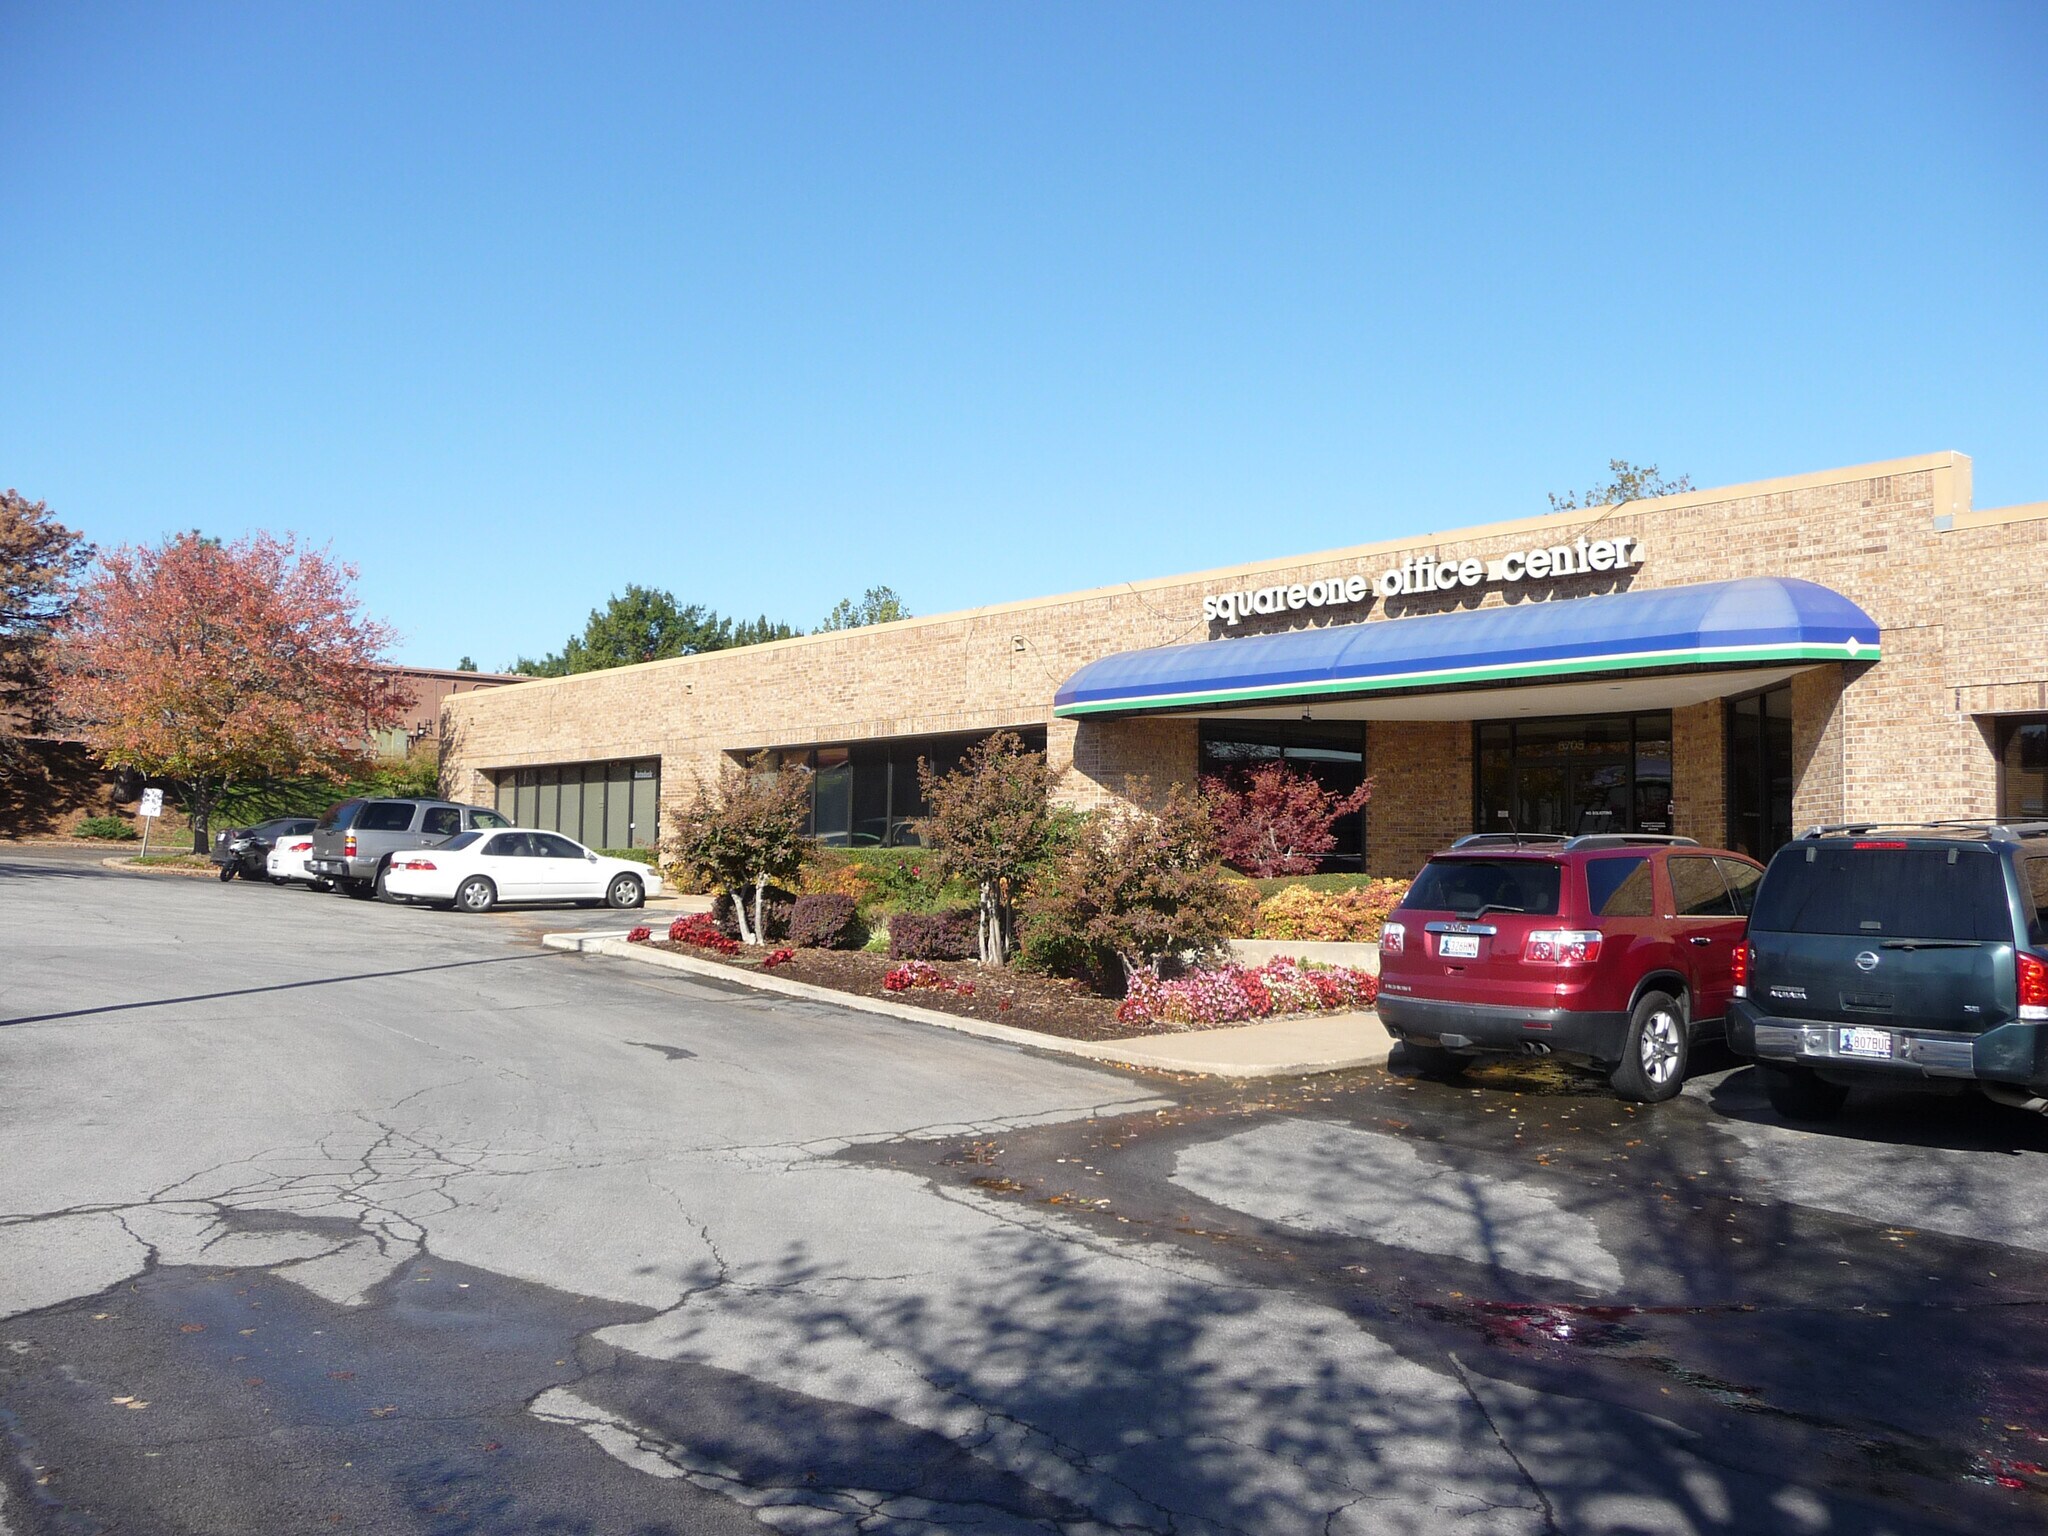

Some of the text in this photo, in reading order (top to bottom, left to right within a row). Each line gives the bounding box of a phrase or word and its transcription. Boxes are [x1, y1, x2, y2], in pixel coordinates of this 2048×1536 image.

[1203, 534, 1637, 626] squareone office center
